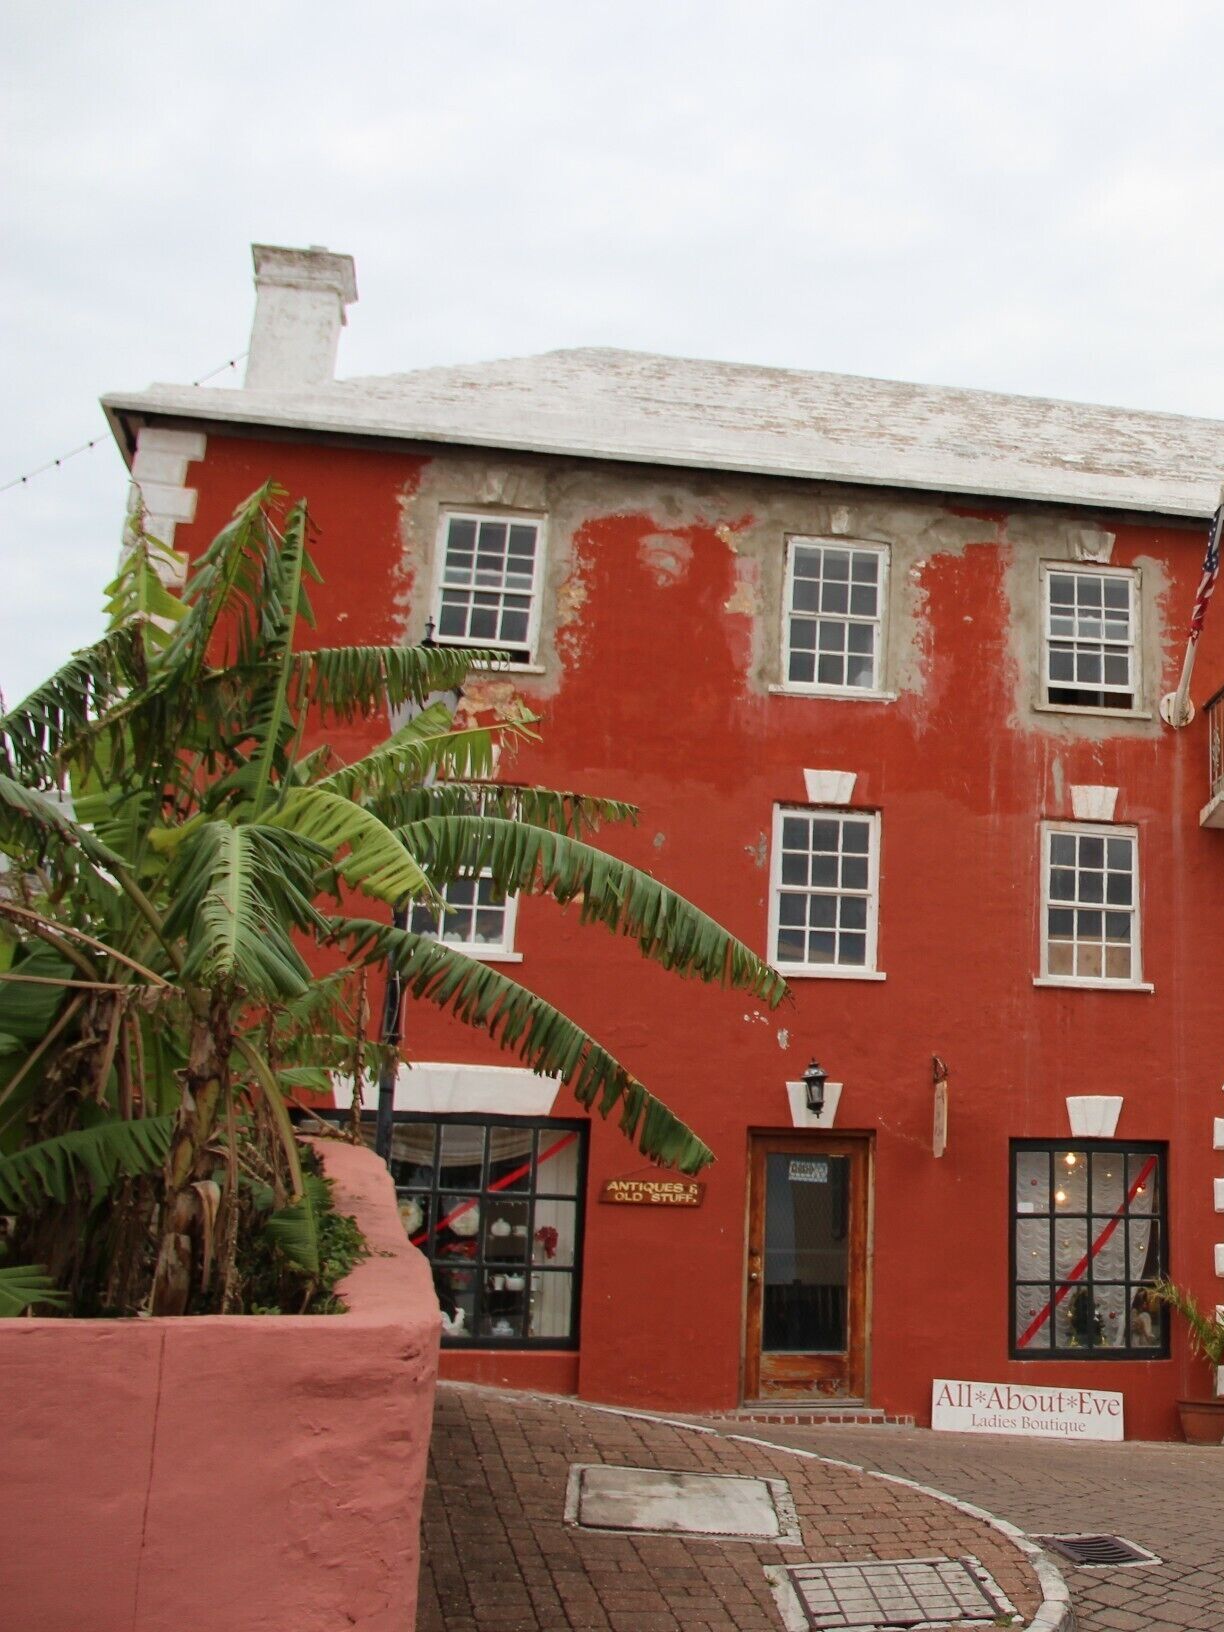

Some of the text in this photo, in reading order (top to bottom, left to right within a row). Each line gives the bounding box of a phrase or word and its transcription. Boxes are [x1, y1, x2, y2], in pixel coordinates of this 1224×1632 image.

[607, 1181, 698, 1195] ANTIQUES &
[614, 1192, 697, 1203] OLD STUFF.
[971, 1413, 1087, 1435] Ladies Boutique
